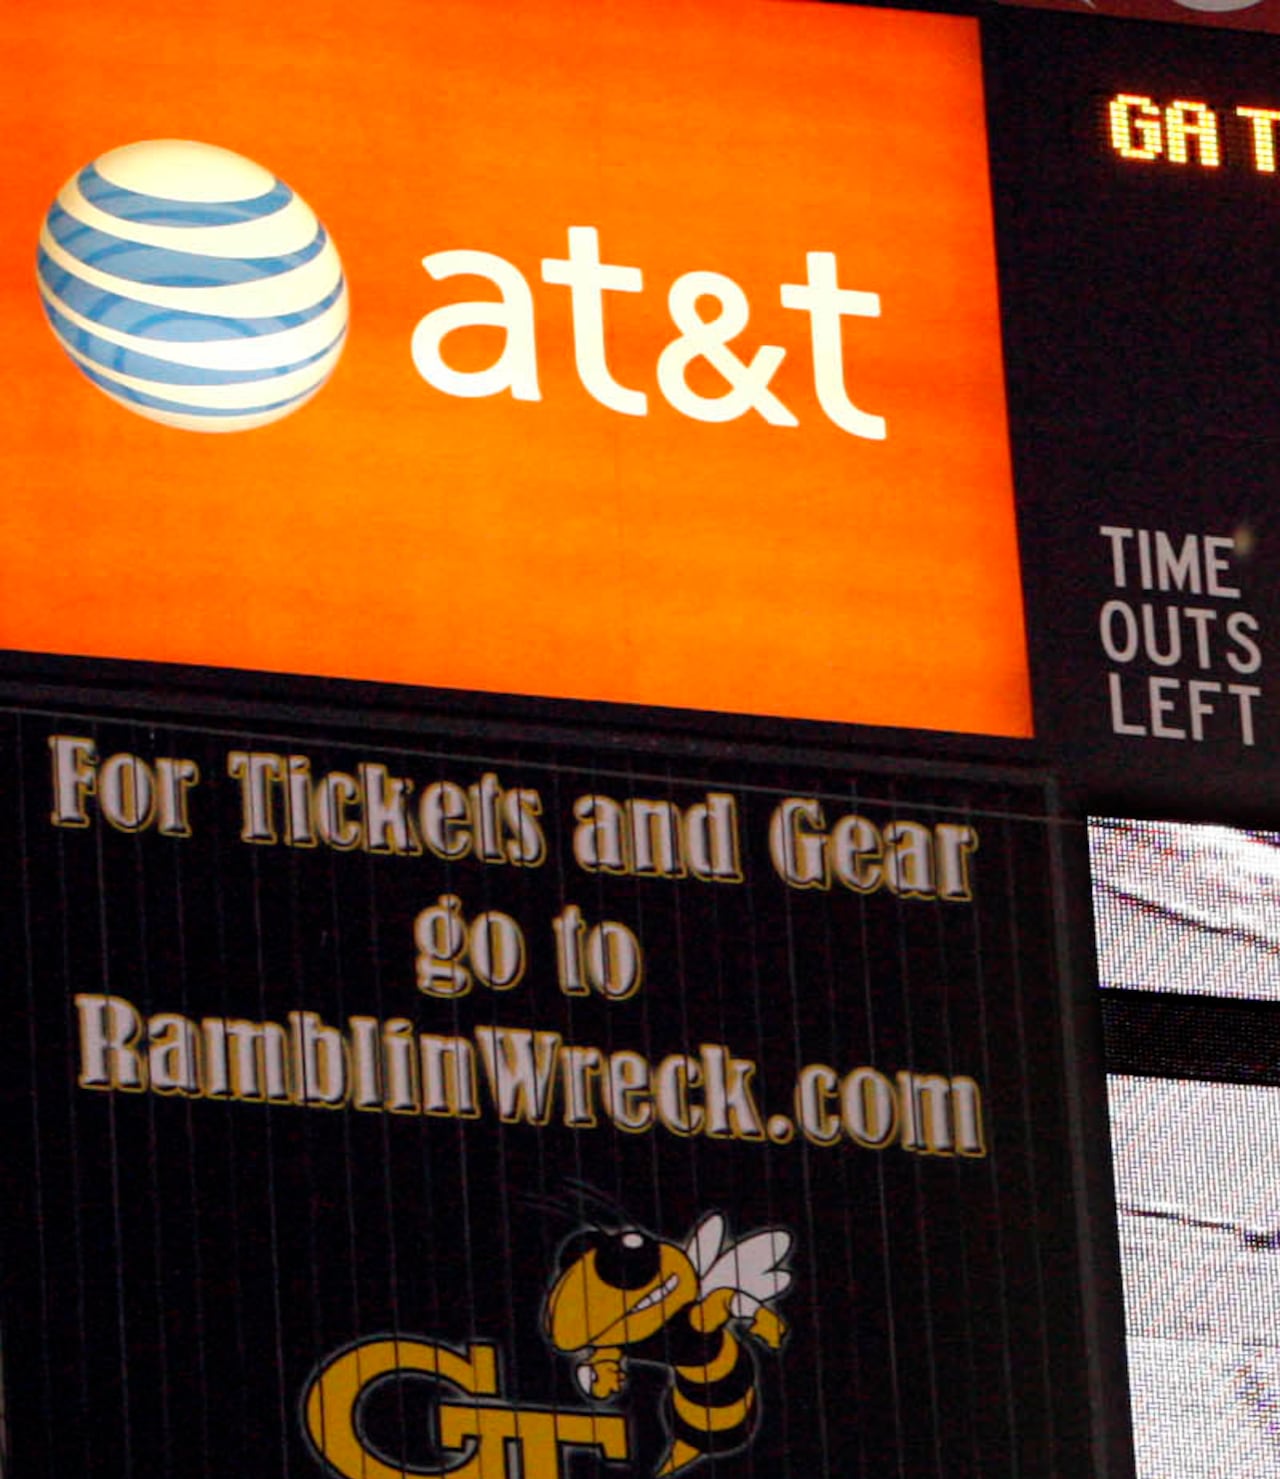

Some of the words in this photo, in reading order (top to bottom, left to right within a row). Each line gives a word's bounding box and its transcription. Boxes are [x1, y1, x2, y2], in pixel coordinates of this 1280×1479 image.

[1109, 93, 1219, 167] GA
[411, 226, 886, 440] at&t
[1100, 525, 1241, 598] TIME
[1100, 600, 1262, 674] OUTS
[1107, 672, 1262, 746] LEFT
[47, 734, 199, 837] For
[227, 749, 547, 868] Tickets
[572, 789, 743, 883] and
[768, 796, 978, 902] Gear
[413, 893, 526, 999] go
[552, 904, 643, 999] to
[74, 992, 988, 1158] RamblinWreck.com
